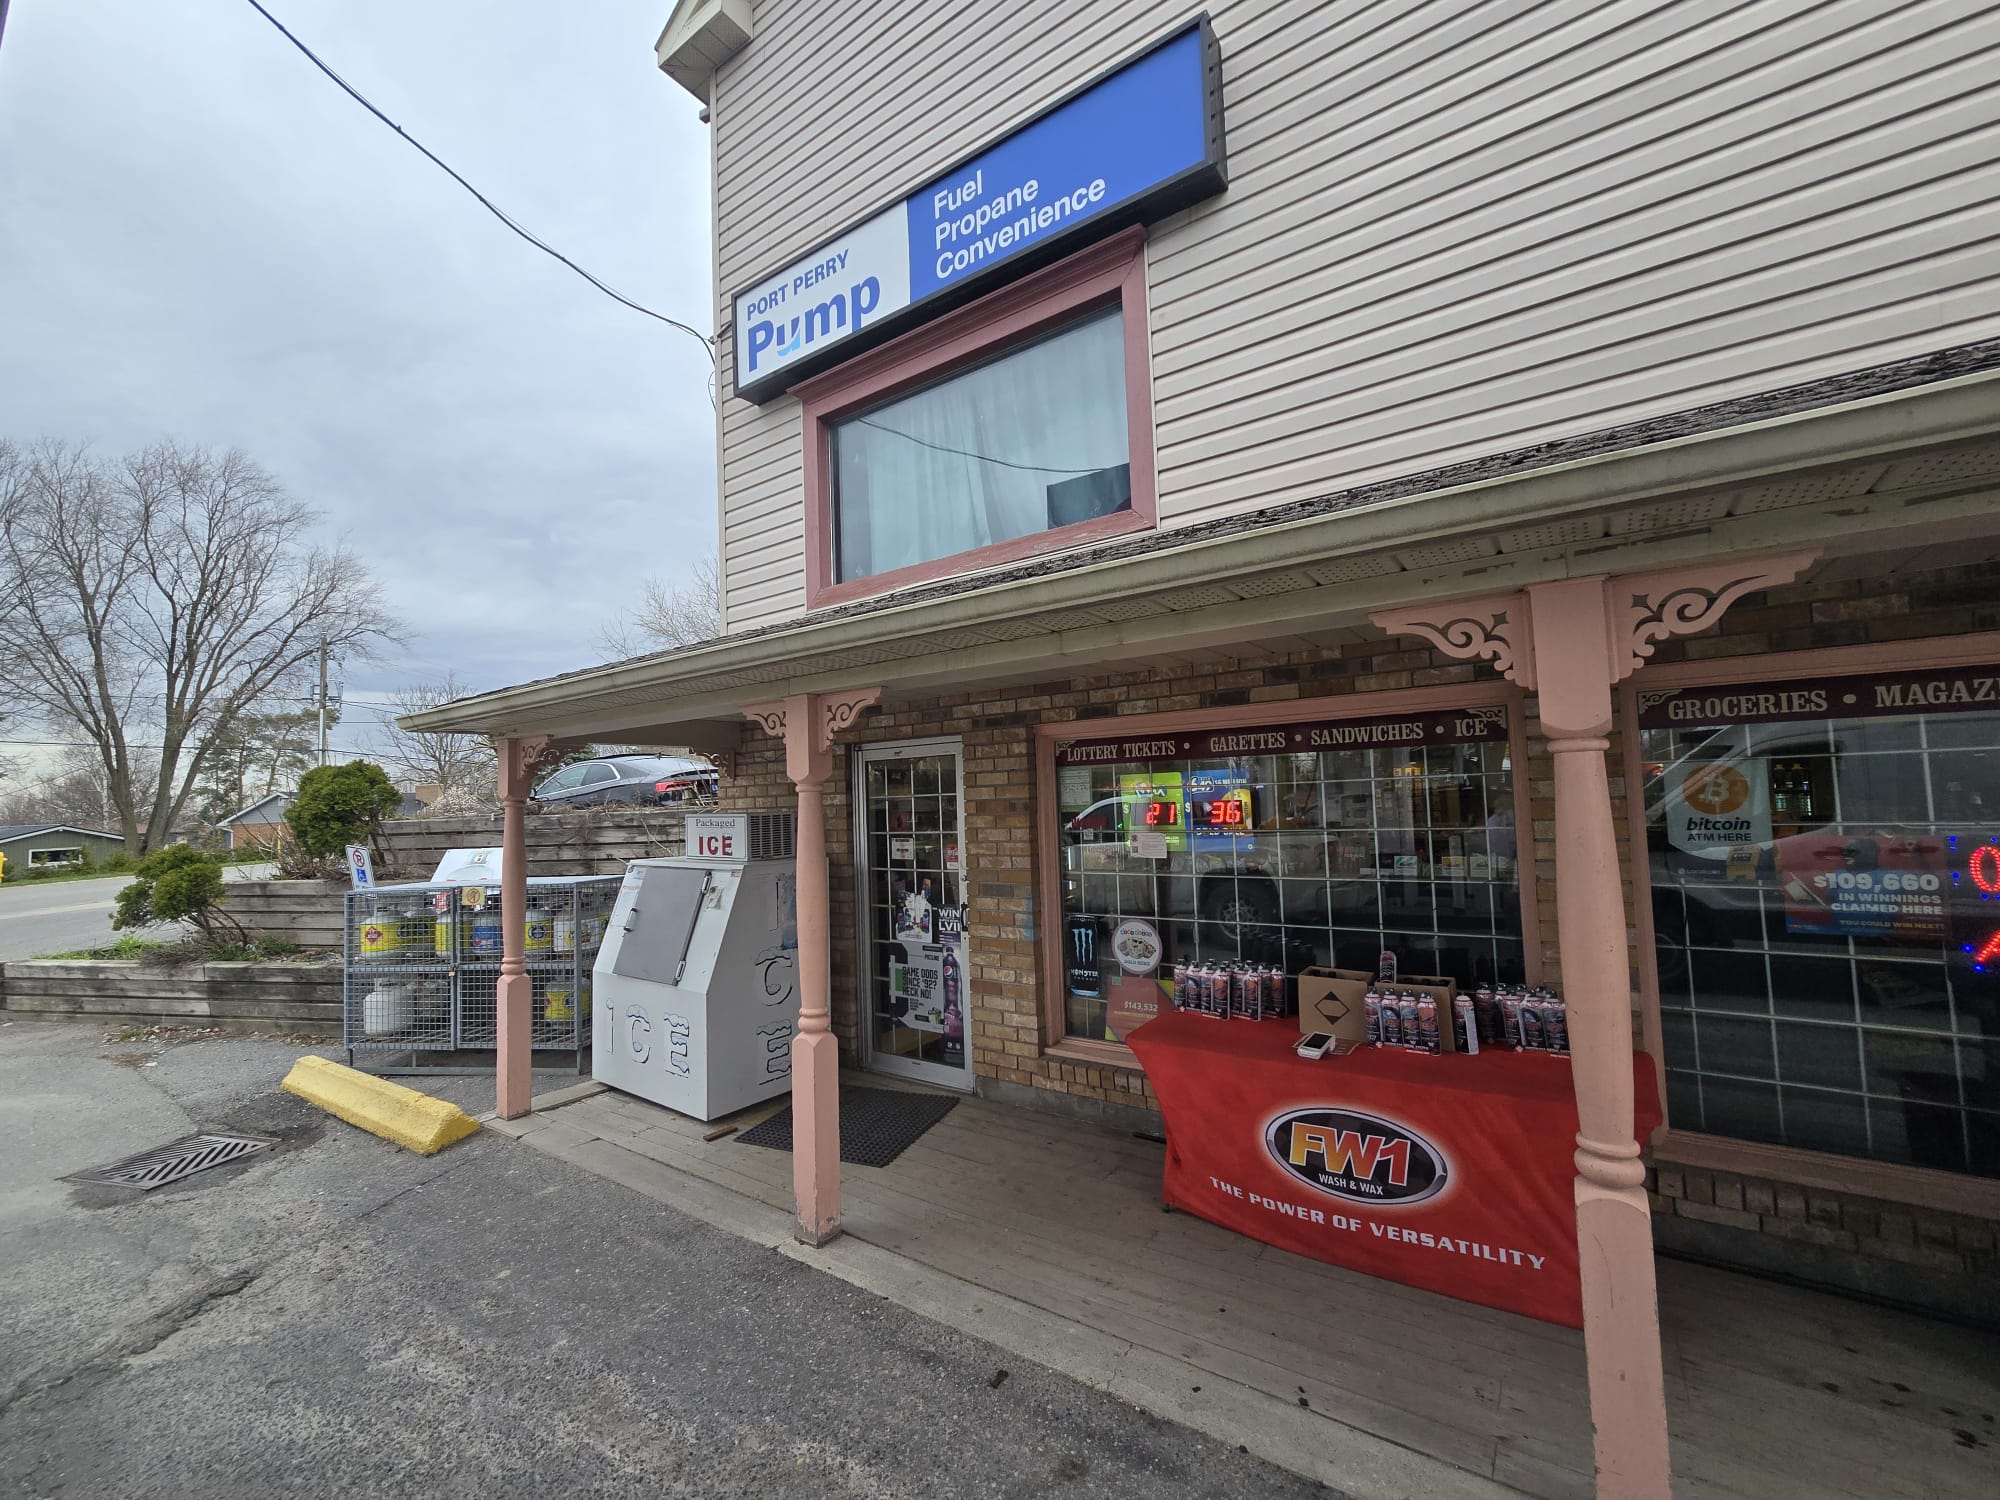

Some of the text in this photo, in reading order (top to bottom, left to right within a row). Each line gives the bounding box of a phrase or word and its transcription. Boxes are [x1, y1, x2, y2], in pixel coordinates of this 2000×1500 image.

[934, 170, 984, 219] Fuel
[935, 177, 1039, 250] Propane
[936, 177, 1106, 280] Convenience
[746, 249, 849, 321] PORT PERRY
[748, 274, 880, 373] Pump
[1667, 689, 1828, 721] GROCERIES
[1067, 718, 1488, 762] LOTTERY TICKETS GARETTES SANDWICHES ICE
[1210, 800, 1242, 824] 36
[695, 819, 736, 829] Packaged
[1687, 817, 1751, 831] bitcoin
[698, 834, 733, 856] ICE
[1687, 833, 1752, 842] ATM HERE
[1813, 872, 1940, 892] $109,660
[1831, 902, 1944, 916] CLAIMED HERE
[1839, 892, 1941, 904] IN WINNINGS
[938, 908, 960, 918] WIN
[902, 966, 938, 980] SAME ODDS
[902, 976, 920, 987] SINCE
[902, 986, 932, 1000] HECK NO!
[1124, 1001, 1158, 1012] $143,532
[1289, 1121, 1411, 1187] FW1
[1318, 1172, 1384, 1196] WASH & WAX
[1209, 1176, 1546, 1270] THE POWER OF VERSATILITY
